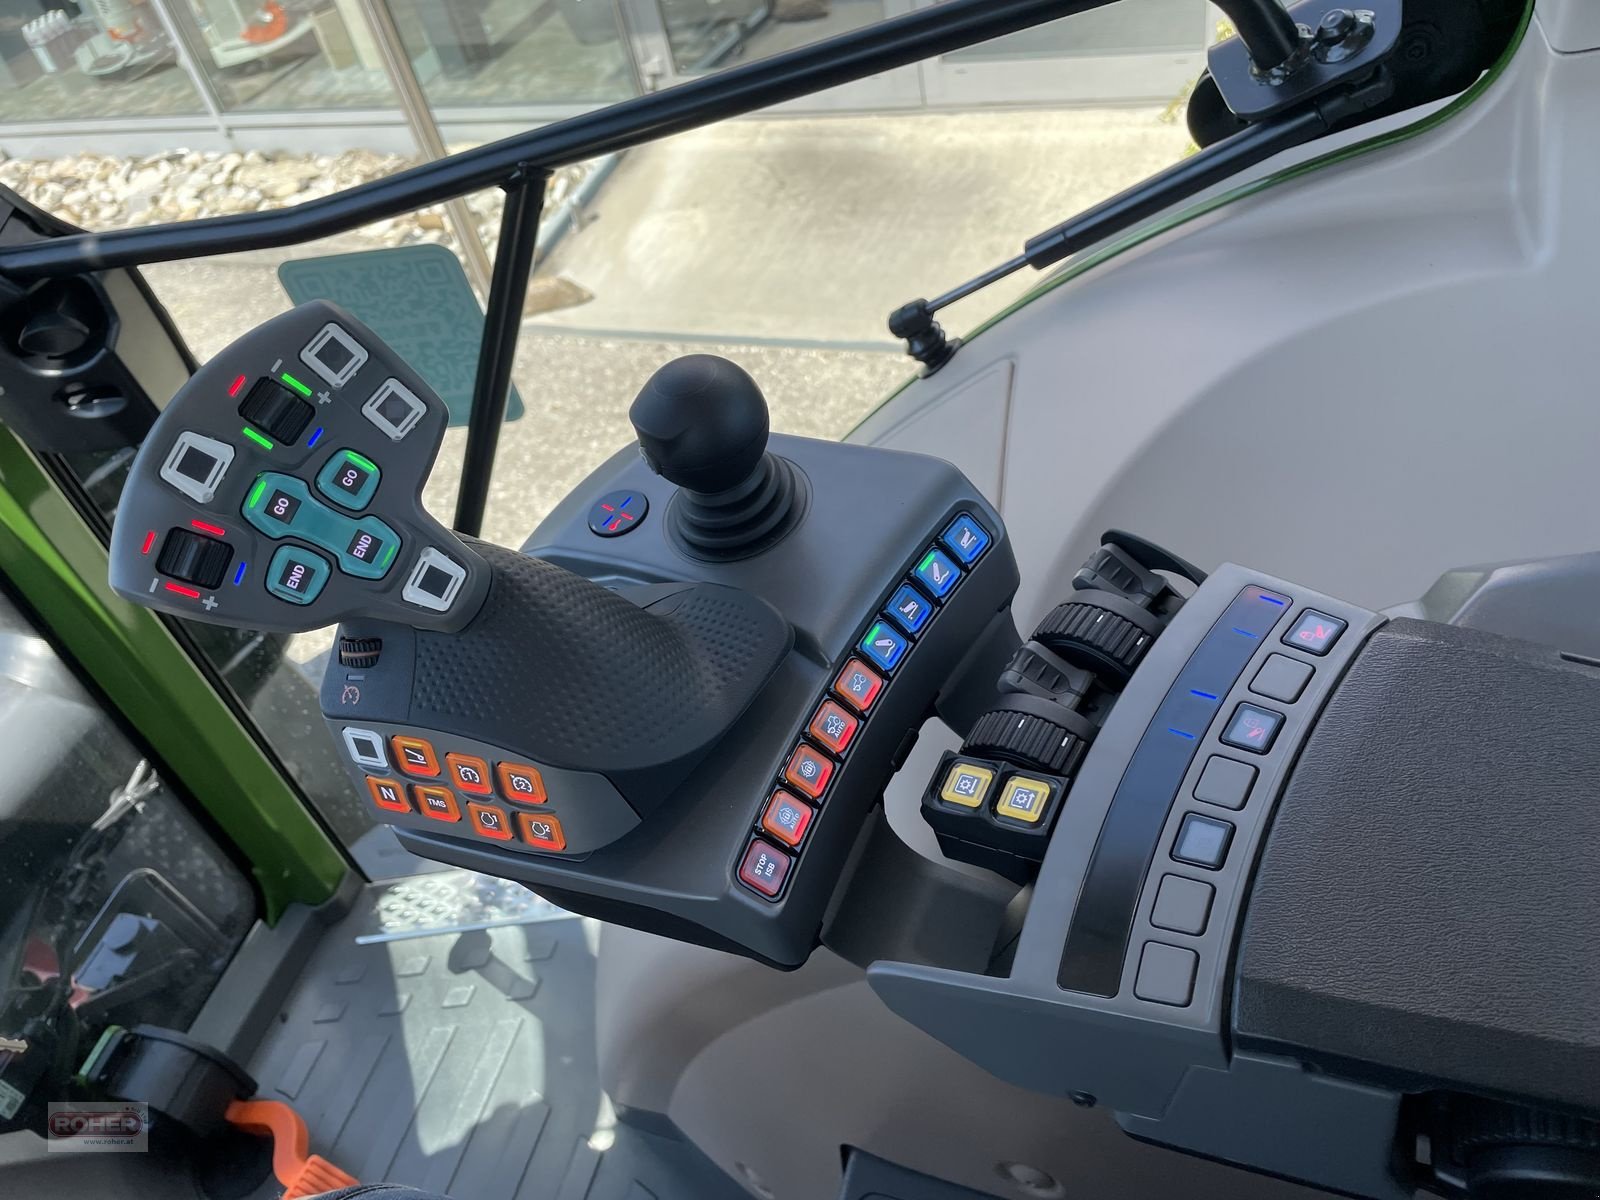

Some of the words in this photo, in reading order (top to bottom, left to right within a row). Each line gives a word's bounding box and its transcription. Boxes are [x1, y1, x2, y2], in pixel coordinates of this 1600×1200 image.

[342, 469, 358, 487] GO
[273, 497, 289, 515] GO
[352, 534, 372, 559] END
[286, 564, 305, 590] END
[834, 721, 846, 738] AUTO
[380, 786, 396, 801] N
[519, 781, 526, 790] 2
[427, 798, 447, 808] TMS
[492, 815, 498, 823] 1
[790, 813, 800, 830] AUTO
[544, 824, 551, 833] 2
[754, 853, 768, 876] STOP
[764, 862, 776, 877] ISB
